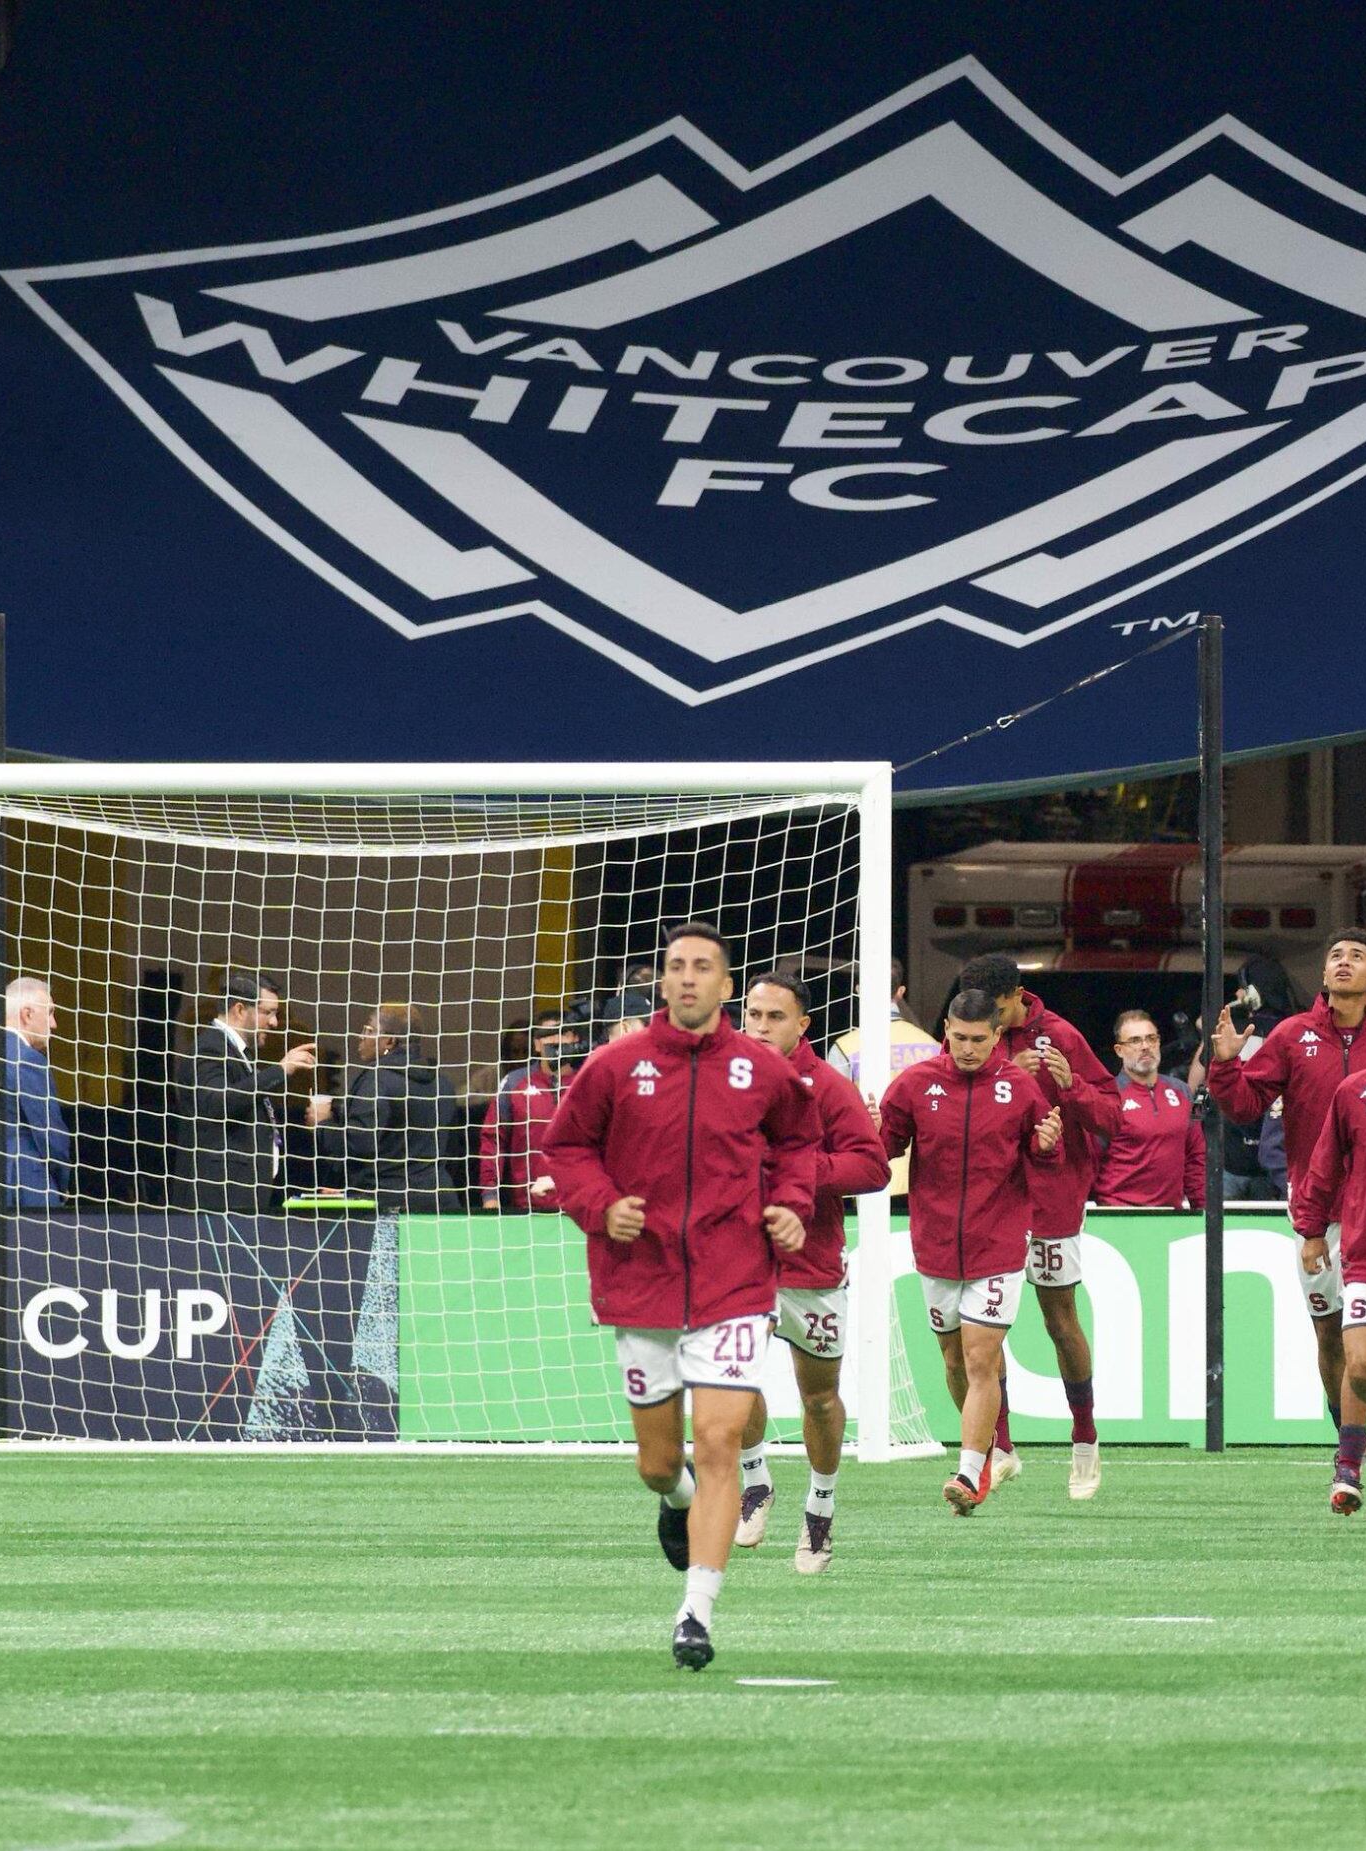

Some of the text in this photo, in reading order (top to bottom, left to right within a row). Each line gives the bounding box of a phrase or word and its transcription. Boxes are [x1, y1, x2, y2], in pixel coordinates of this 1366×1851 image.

[436, 319, 1309, 387] VANCOUVER
[656, 458, 949, 511] FC
[1111, 611, 1200, 636] TM
[1305, 1046, 1318, 1057] 27
[728, 1057, 753, 1089] S
[637, 1080, 655, 1095] 20
[994, 1081, 1012, 1103] S
[1164, 1089, 1180, 1107] S
[1032, 1240, 1063, 1271] 36
[987, 1276, 1004, 1307] 5
[1309, 1293, 1328, 1312] S
[22, 1287, 228, 1359] CUP
[804, 1313, 839, 1342] 25
[930, 1307, 944, 1328] S
[713, 1323, 755, 1362] 20
[627, 1368, 646, 1396] S
